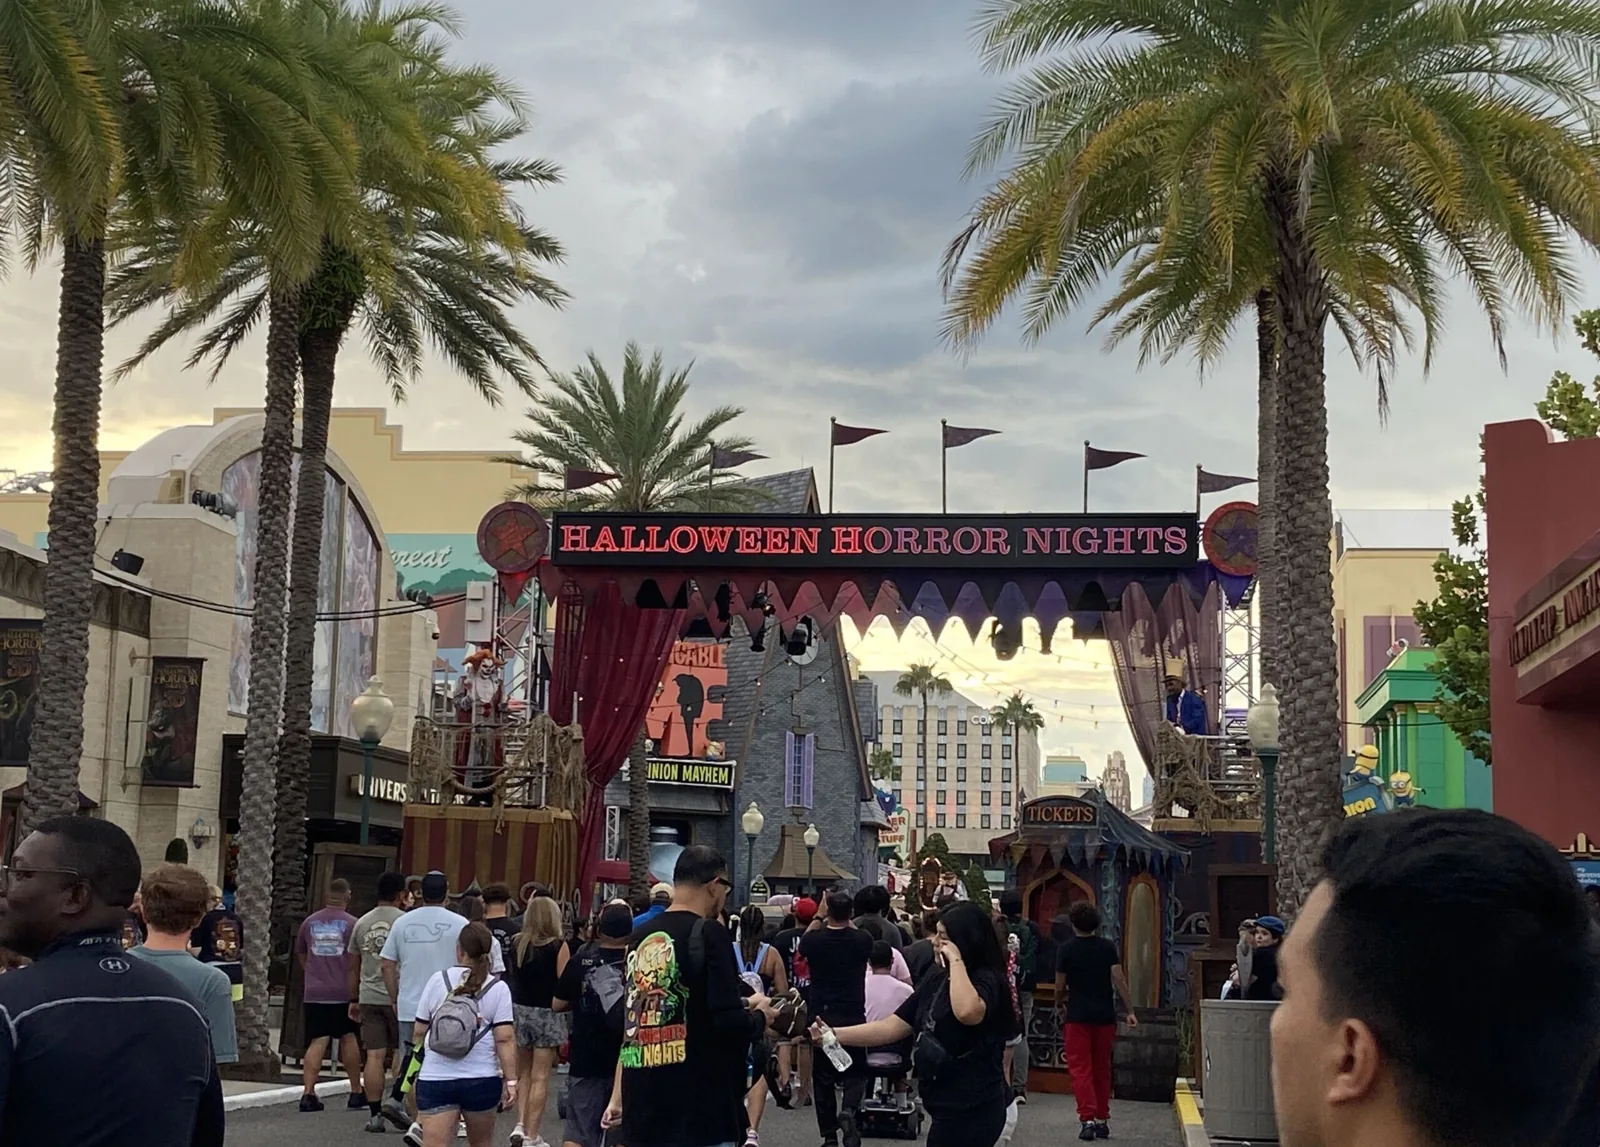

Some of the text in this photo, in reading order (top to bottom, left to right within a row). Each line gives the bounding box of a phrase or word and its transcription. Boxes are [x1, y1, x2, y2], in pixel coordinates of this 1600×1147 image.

[560, 525, 1188, 555] HALLOWEEN HORROR NIGHTS
[647, 762, 729, 785] INION MAYHEM
[358, 773, 408, 803] UNIVERS
[1027, 806, 1094, 823] TICKETS
[880, 834, 905, 844] TUFF
